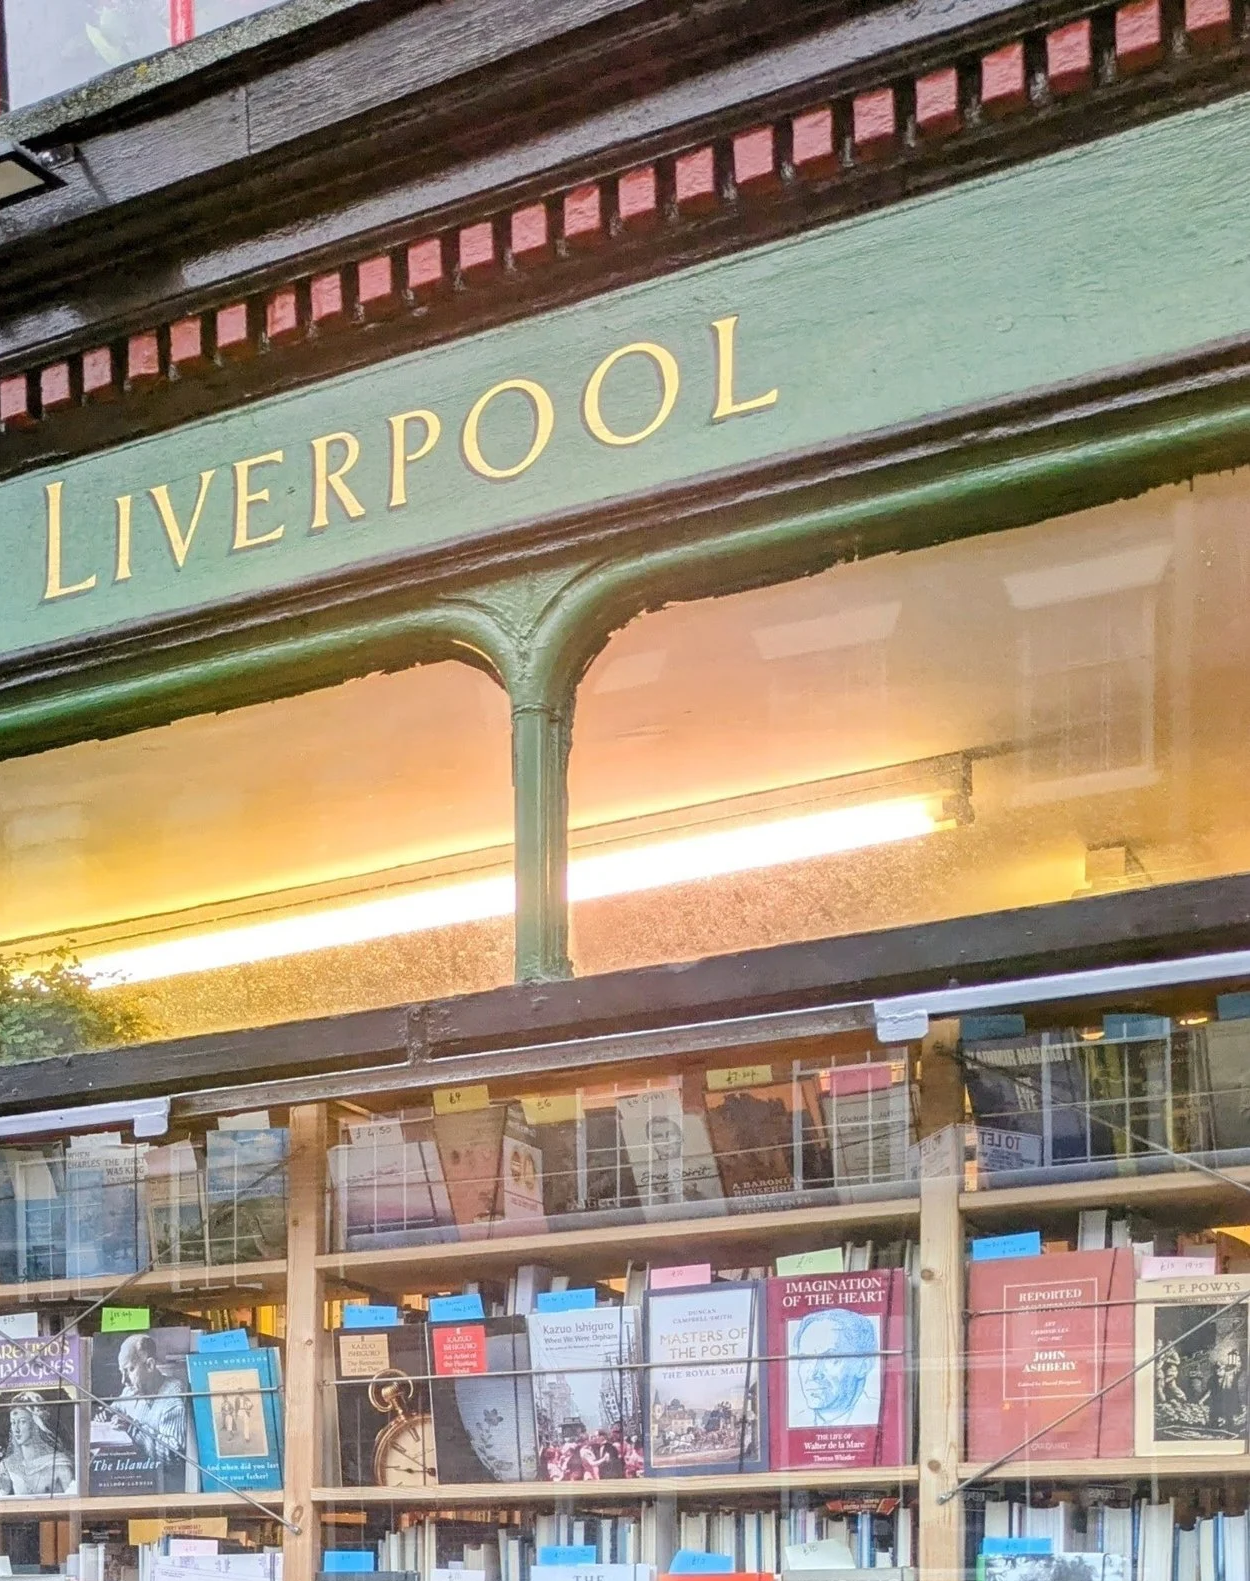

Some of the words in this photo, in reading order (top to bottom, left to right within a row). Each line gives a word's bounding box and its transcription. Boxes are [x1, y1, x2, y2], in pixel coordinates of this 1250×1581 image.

[42, 315, 779, 602] LIVERPOOL
[786, 1278, 882, 1294] IMAGINATION
[782, 1295, 801, 1308] OF
[804, 1293, 834, 1305] THE
[838, 1291, 886, 1302] HEART
[1018, 1288, 1082, 1302] REPORTED
[542, 1323, 572, 1334] Kazuo
[575, 1322, 614, 1334] Ishiguro
[670, 1347, 696, 1359] THE
[701, 1344, 738, 1357] POST
[1033, 1350, 1066, 1361] JOHN
[1022, 1360, 1078, 1373] ASHBERY
[94, 1460, 112, 1472] The
[116, 1459, 161, 1472] Islander
